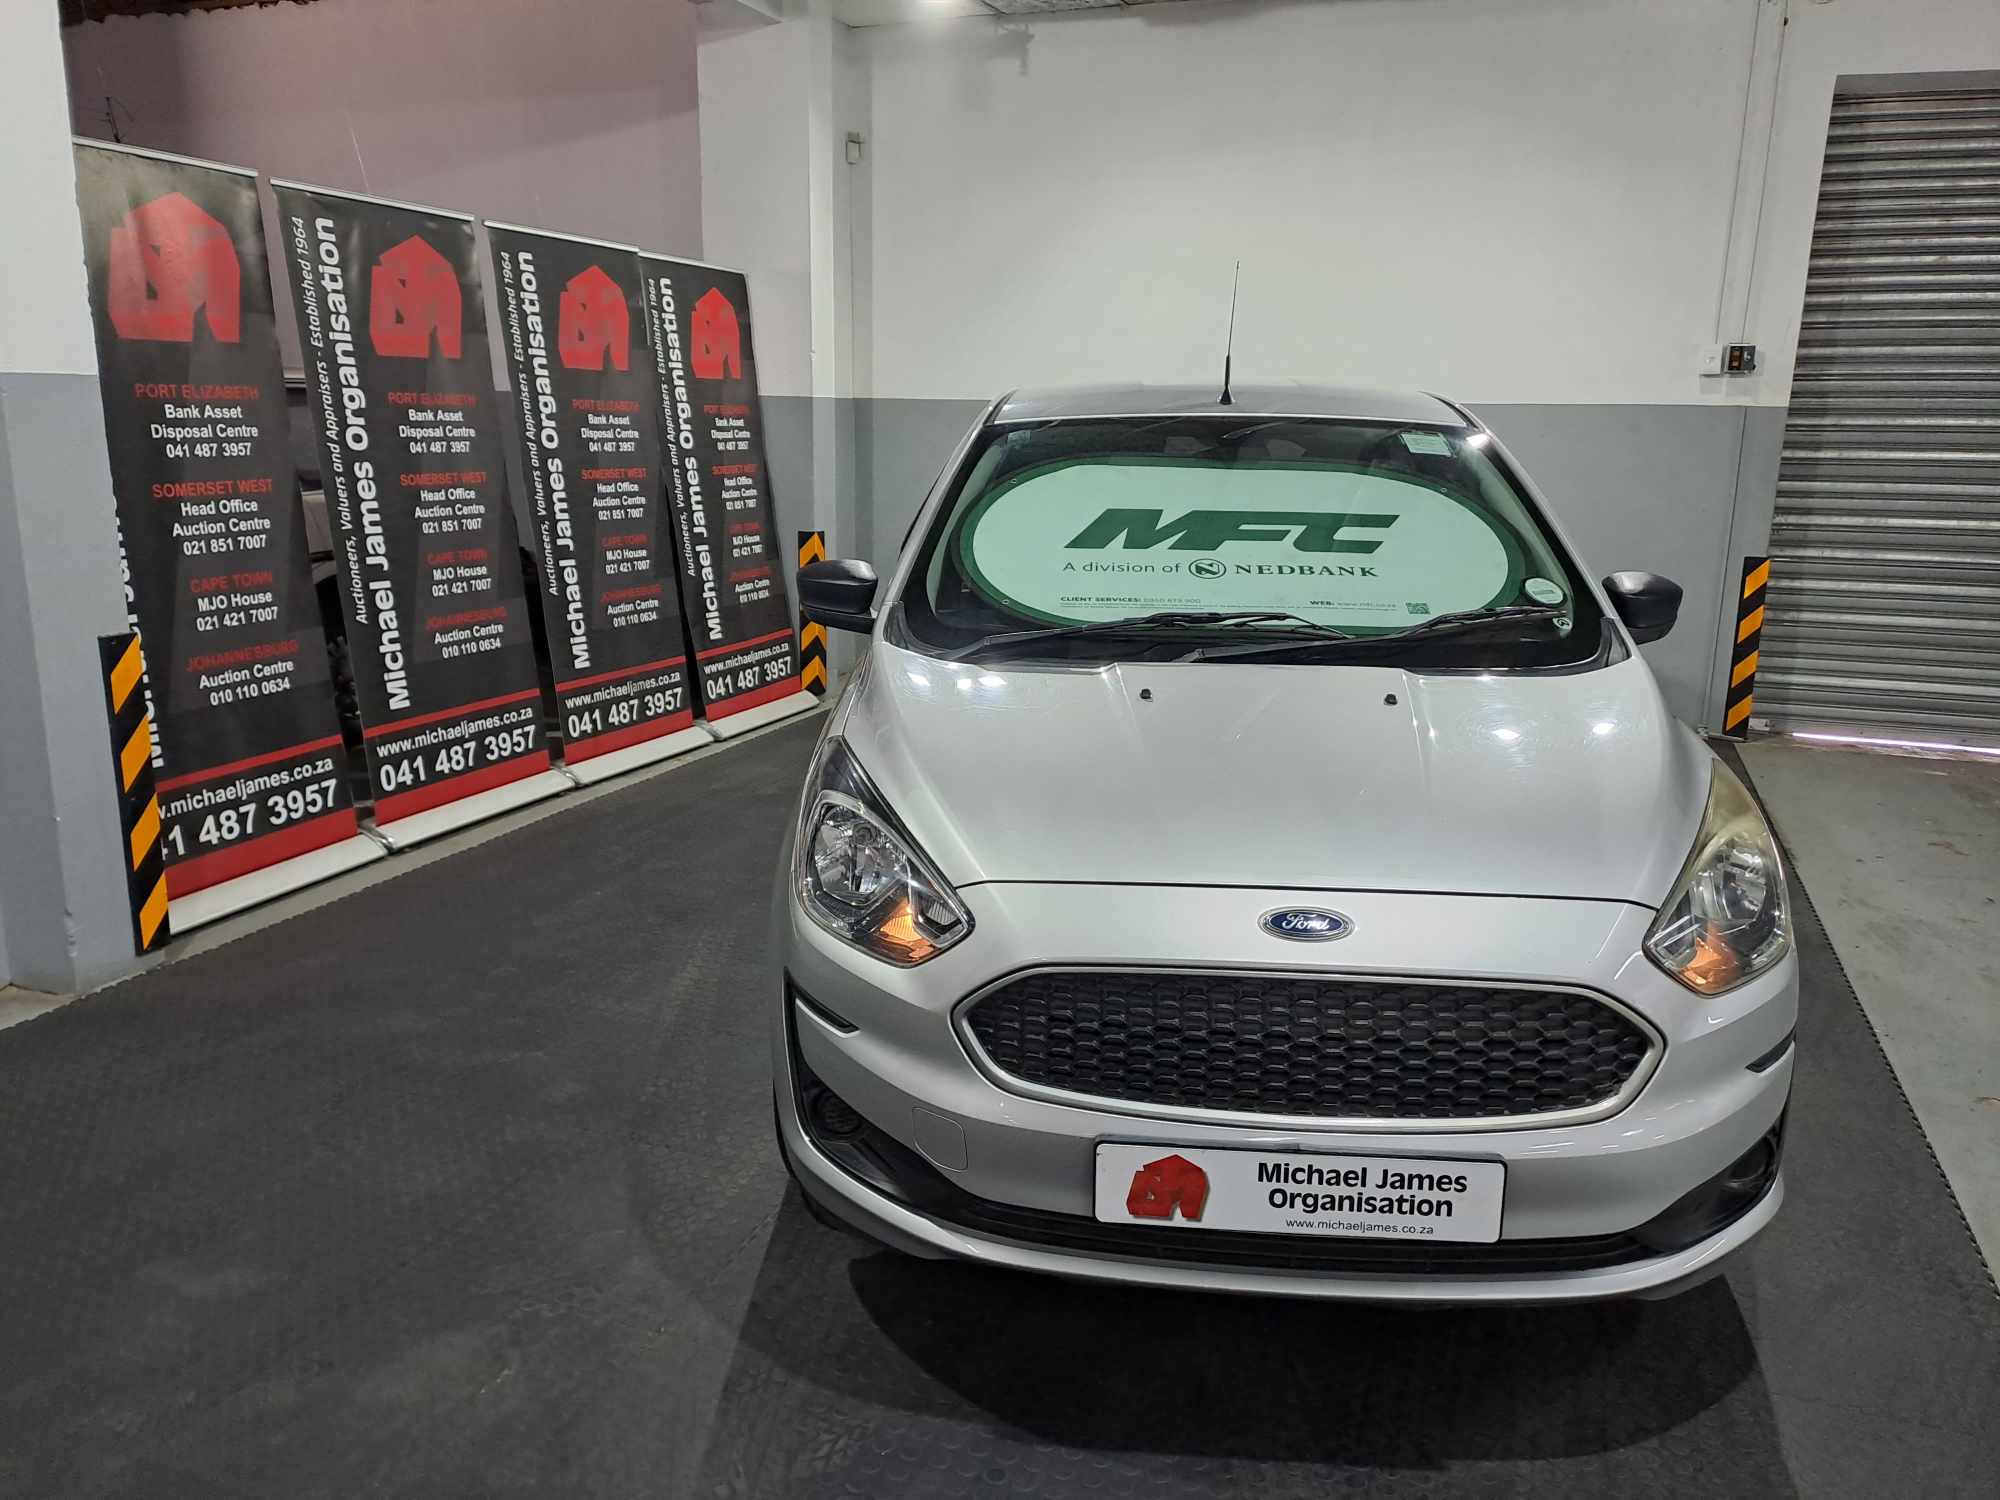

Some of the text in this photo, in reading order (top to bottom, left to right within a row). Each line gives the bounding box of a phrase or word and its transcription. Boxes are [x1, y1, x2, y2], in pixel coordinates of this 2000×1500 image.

[291, 216, 309, 256] 1964
[500, 251, 514, 284] 1964
[297, 258, 324, 348] Established
[505, 286, 524, 362] Established
[134, 384, 260, 400] PORT ELIZABETH
[317, 361, 339, 440] Appraisers
[387, 392, 417, 404] PORT
[164, 403, 243, 418] Bank Asset
[408, 409, 464, 422] Bank Asset
[519, 372, 537, 440] Appraisers
[587, 414, 607, 425] Bank
[150, 423, 258, 441] Disposal Centre
[399, 425, 476, 439] Disposal Centre
[581, 428, 639, 440] Disposal Centre
[166, 442, 252, 458] 041 487 3957
[326, 442, 344, 473] and
[410, 441, 470, 453] 041 487 3957
[526, 441, 540, 468] and
[589, 442, 602, 452] 041
[668, 444, 679, 466] and
[315, 217, 411, 711] Michael James Organisation
[518, 251, 592, 671] Michael James Organisation
[660, 277, 723, 641] Michael James Organisation
[152, 478, 273, 498] SOMERSET WEST
[400, 472, 457, 485] SOMERSET
[597, 482, 639, 493] Head Office
[673, 468, 685, 508] Valuers
[333, 475, 352, 530] Valuers
[420, 488, 476, 502] Head Office
[532, 470, 547, 517] Valuers
[593, 495, 646, 507] Auction Centre
[180, 499, 258, 516] Head Office
[415, 504, 485, 519] Auction Centre
[598, 510, 611, 520] 021
[172, 517, 271, 537] Auction Centre
[422, 518, 482, 534] 021 851 7007
[1063, 508, 1400, 554] MFC
[183, 534, 267, 555] 021 851 7007
[606, 549, 647, 560] MJO House
[541, 520, 559, 596] Auctioneers,
[605, 560, 650, 574] 021 421 7007
[433, 565, 487, 581] MJO House
[1063, 561, 1379, 577] A division of NEDBANK
[190, 570, 273, 593] CAPE TOWN
[345, 535, 369, 625] Auctioneers,
[432, 578, 492, 597] 021 421 7007
[197, 591, 273, 612] MJO House
[607, 602, 634, 615] Auction
[196, 606, 279, 631] 021 421 7007
[627, 614, 639, 625] 110
[434, 623, 504, 644] Auction Centre
[442, 637, 501, 659] 010 110 0634
[199, 660, 295, 689] Auction Centre
[706, 656, 792, 700] 041 487 3957
[209, 677, 291, 706] 010 110 0634
[565, 671, 681, 709] www.michaeljames.co.za
[568, 687, 682, 738] 041 487 3957
[376, 706, 533, 758] www.michaeljames.co.za
[379, 724, 536, 792] 041 487 3957
[199, 802, 257, 846] 487
[267, 778, 338, 826] 3957
[1282, 913, 1330, 930] Ford
[1257, 1162, 1468, 1193] Michael James
[1268, 1188, 1453, 1217] Organisation
[1286, 1218, 1434, 1235] www.michaeljames.co.za
